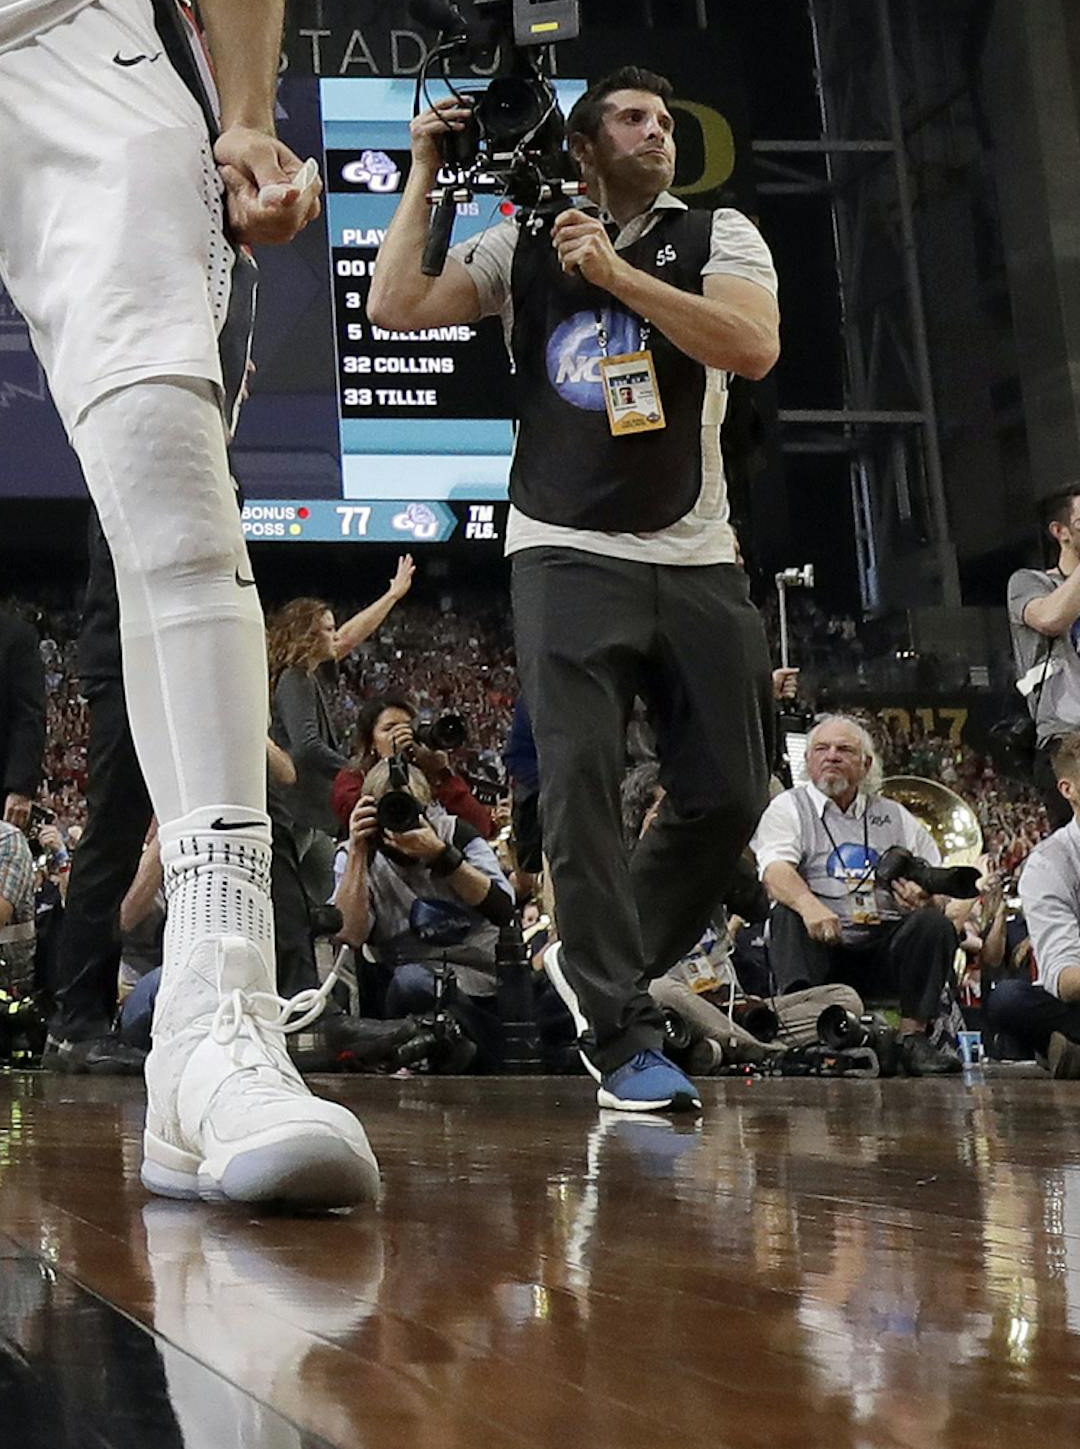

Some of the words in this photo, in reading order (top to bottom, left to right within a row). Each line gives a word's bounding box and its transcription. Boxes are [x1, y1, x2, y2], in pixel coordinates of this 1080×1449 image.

[342, 228, 388, 245] PLAY
[337, 260, 366, 277] 00
[345, 292, 361, 309] 3
[347, 323, 362, 340] 5
[343, 356, 371, 373] 32
[374, 357, 455, 374] COLLINS
[555, 355, 604, 384] NC
[344, 388, 372, 405] 33
[375, 389, 437, 406] TILLIE
[242, 506, 296, 520] BONUS
[336, 506, 371, 536] 77
[468, 505, 495, 522] TM
[244, 522, 285, 536] POSS
[466, 523, 499, 540] FLS.
[880, 707, 969, 746] 017
